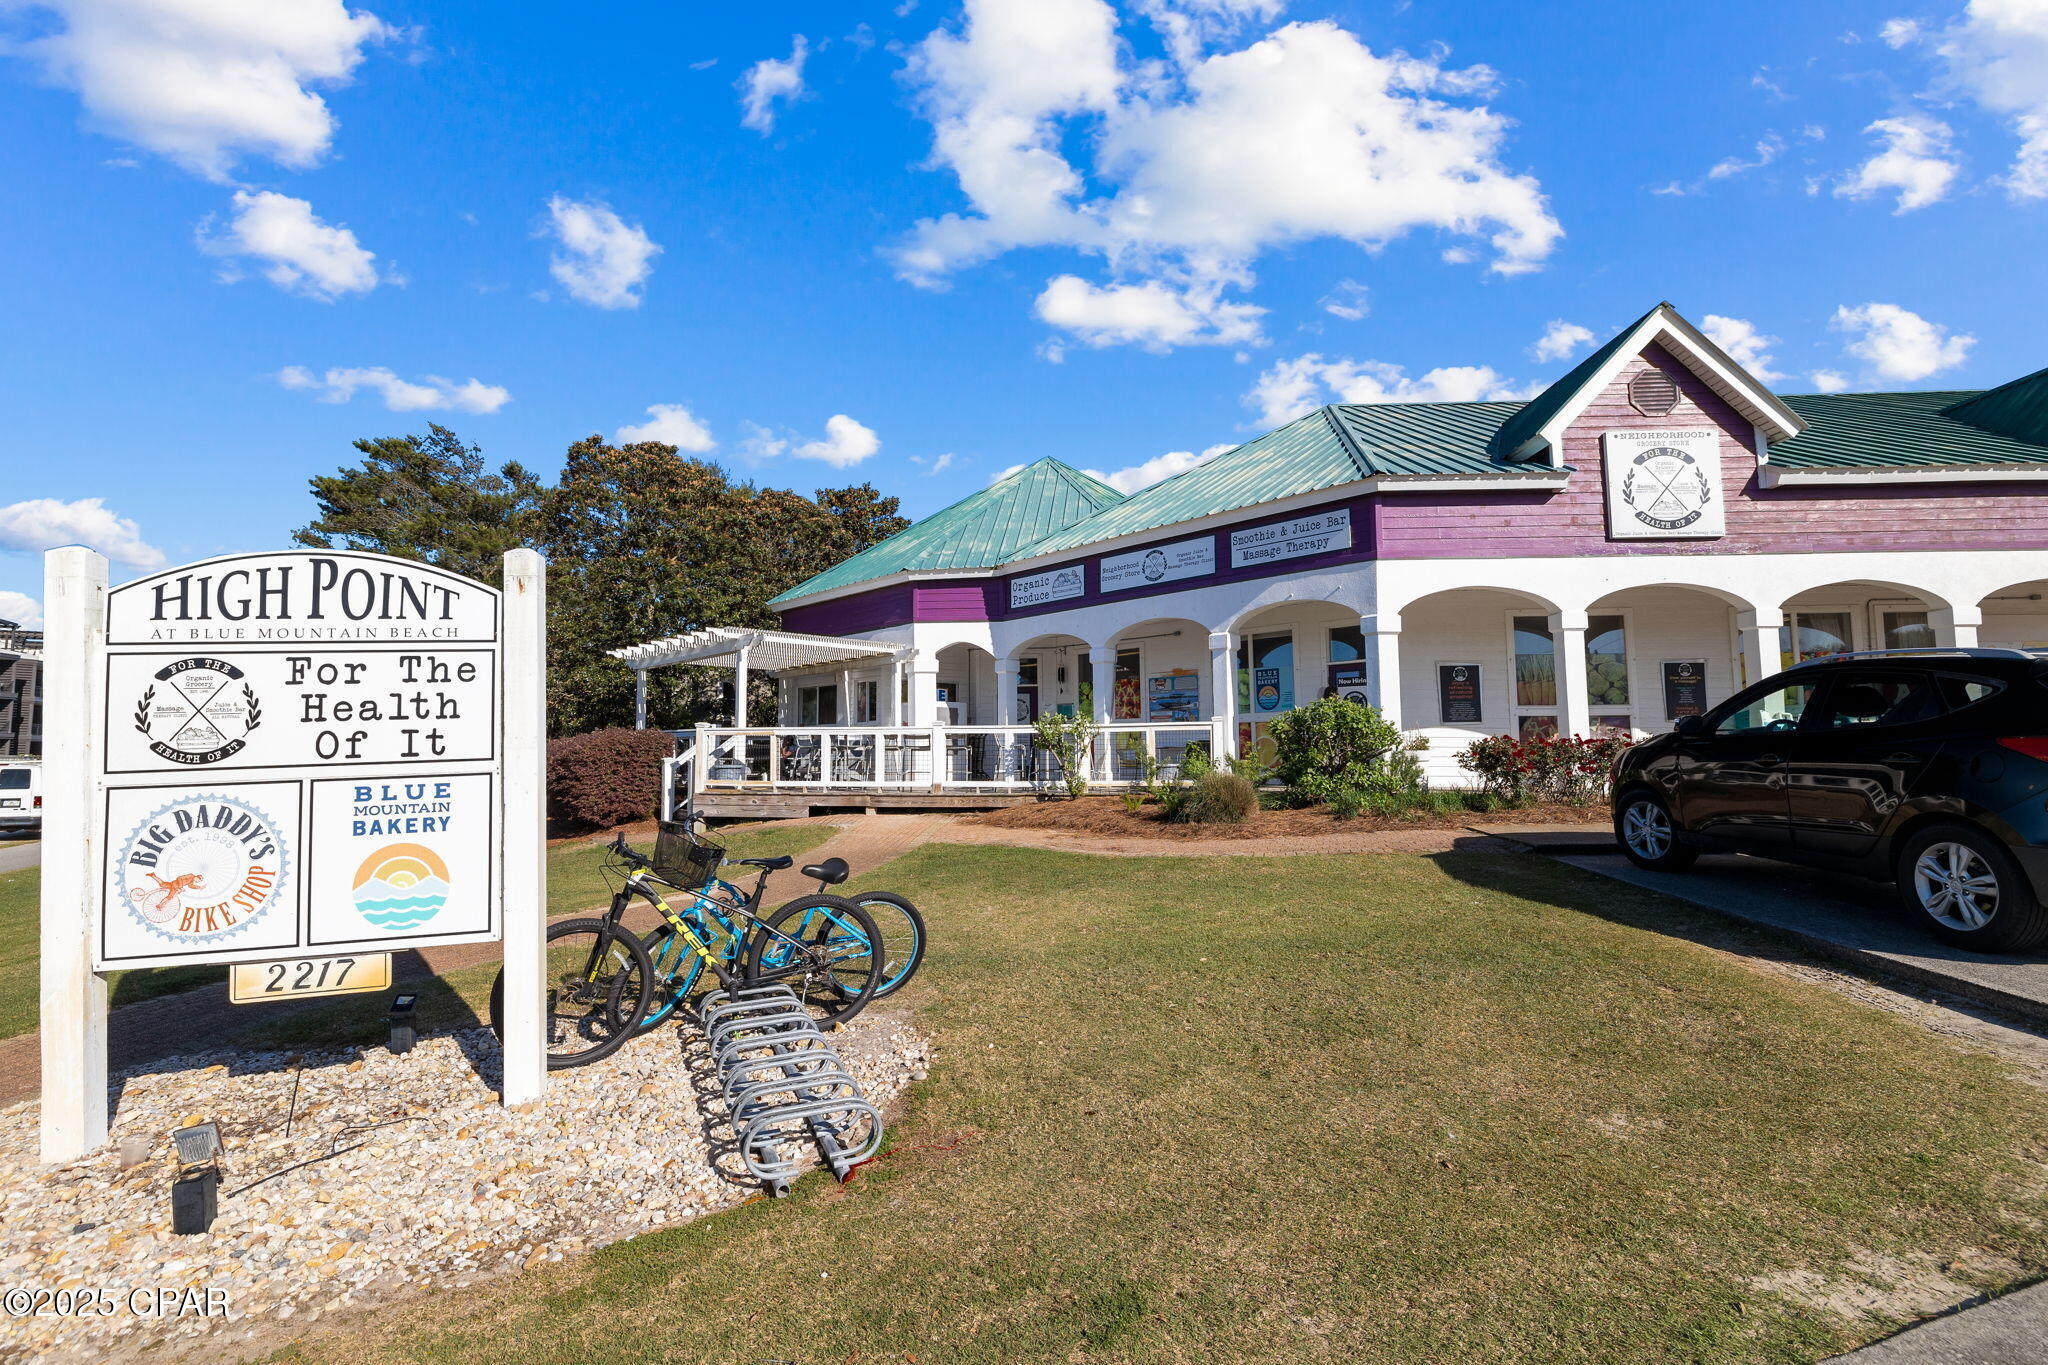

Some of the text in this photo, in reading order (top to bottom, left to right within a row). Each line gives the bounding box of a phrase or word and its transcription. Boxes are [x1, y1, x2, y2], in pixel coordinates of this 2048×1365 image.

[1620, 432, 1705, 440] NEIGHBORHOOD
[1642, 448, 1686, 460] FOR THE
[1638, 512, 1698, 528] HEALTH OF IT
[1233, 515, 1347, 546] Smoothie & Juice Bar
[1242, 537, 1330, 561] Massage Therapy
[1101, 573, 1123, 583] Grocery
[1125, 570, 1141, 578] Store
[1102, 561, 1140, 574] Neighborhood
[150, 558, 461, 621] HIGH POINT
[1012, 576, 1050, 593] Organic
[1012, 591, 1050, 606] Produce
[150, 626, 460, 640] AT BLUE MOUNTAIN BEACH
[169, 659, 232, 675] FOR THE
[285, 655, 477, 686] For The
[156, 705, 185, 713] Massage
[300, 691, 461, 723] Health
[155, 741, 240, 763] HEALTH OF IT
[315, 728, 446, 760] Of It
[354, 783, 451, 802] BLUE
[353, 802, 451, 817] MOUNTAIN
[352, 816, 451, 836] BAKERY
[129, 804, 276, 869] BIG DADDY'S
[175, 832, 235, 852] est. 1998
[179, 865, 276, 933] BIKE SHOP
[655, 895, 719, 967] TREK
[265, 958, 357, 992] 2217
